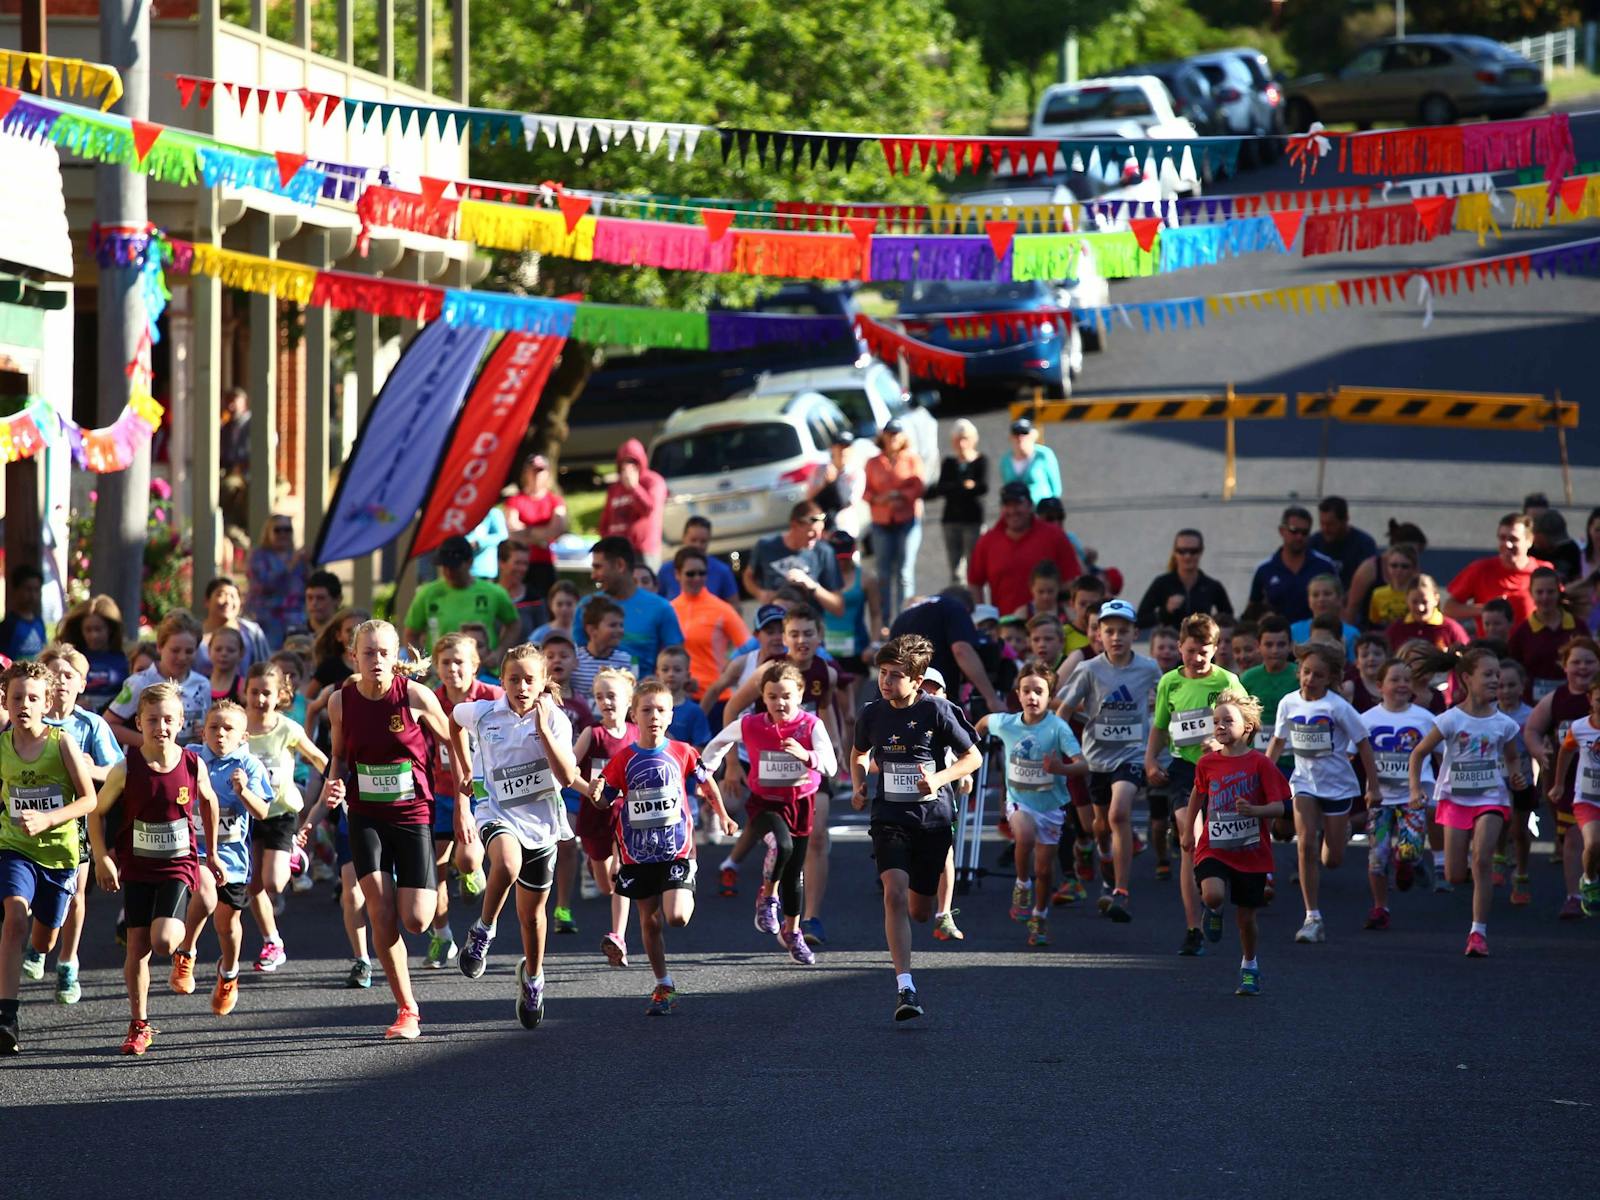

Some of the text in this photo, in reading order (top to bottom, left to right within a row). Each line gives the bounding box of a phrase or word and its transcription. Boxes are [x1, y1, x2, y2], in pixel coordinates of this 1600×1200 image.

[442, 431, 499, 533] DOOR
[1101, 702, 1138, 711] adidas
[1181, 719, 1206, 731] REG
[1102, 726, 1132, 737] SAM
[1293, 732, 1326, 743] GEORGIE
[1368, 725, 1423, 752] GO
[766, 762, 801, 772] LAUREN
[372, 776, 398, 786] CLEO
[893, 775, 922, 785] HENR
[1454, 771, 1494, 781] ARABELLA
[502, 773, 544, 795] HOPE
[14, 797, 59, 810] DANIEL
[633, 797, 677, 814] SIDNEY
[1211, 819, 1257, 837] SAMUEL
[138, 831, 184, 843] STIRLING
